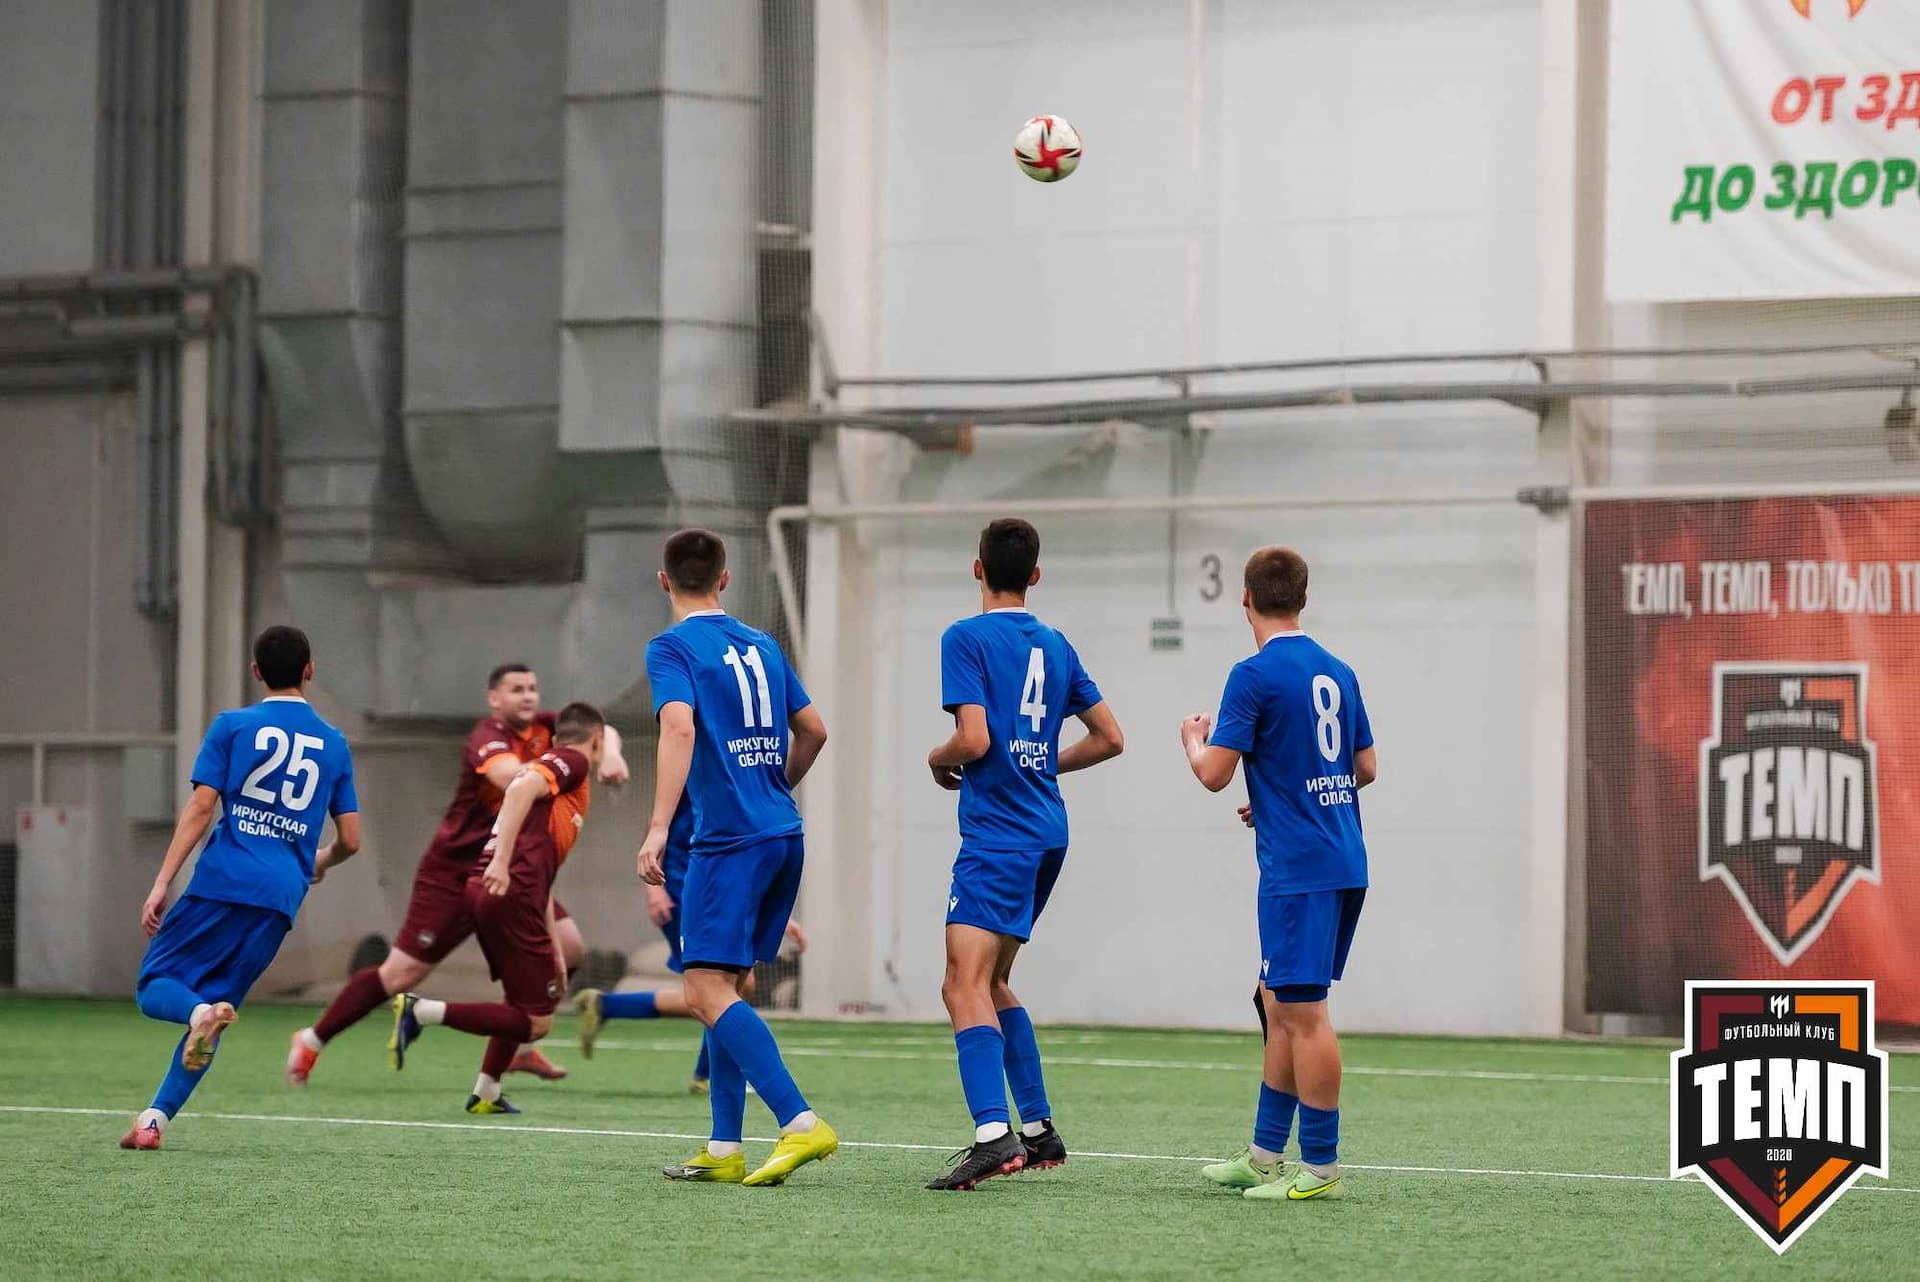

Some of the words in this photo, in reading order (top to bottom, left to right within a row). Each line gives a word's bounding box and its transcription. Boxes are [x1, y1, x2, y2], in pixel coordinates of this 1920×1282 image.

[1771, 75, 1846, 124] ОТ
[1671, 164, 1756, 223] ДО
[1763, 158, 1920, 220] ЗДОР
[1200, 553, 1223, 602] 3
[1701, 560, 1778, 618] ТЕМП,
[1785, 560, 1892, 614] ТОЛЬКО
[1897, 561, 1920, 613] Т
[722, 645, 773, 728] 11
[1020, 647, 1046, 733] 4
[1312, 674, 1341, 763] 8
[241, 726, 324, 811] 25
[1719, 746, 1864, 850] ТЕМП
[232, 804, 308, 836] ИРКУТСКАЯ
